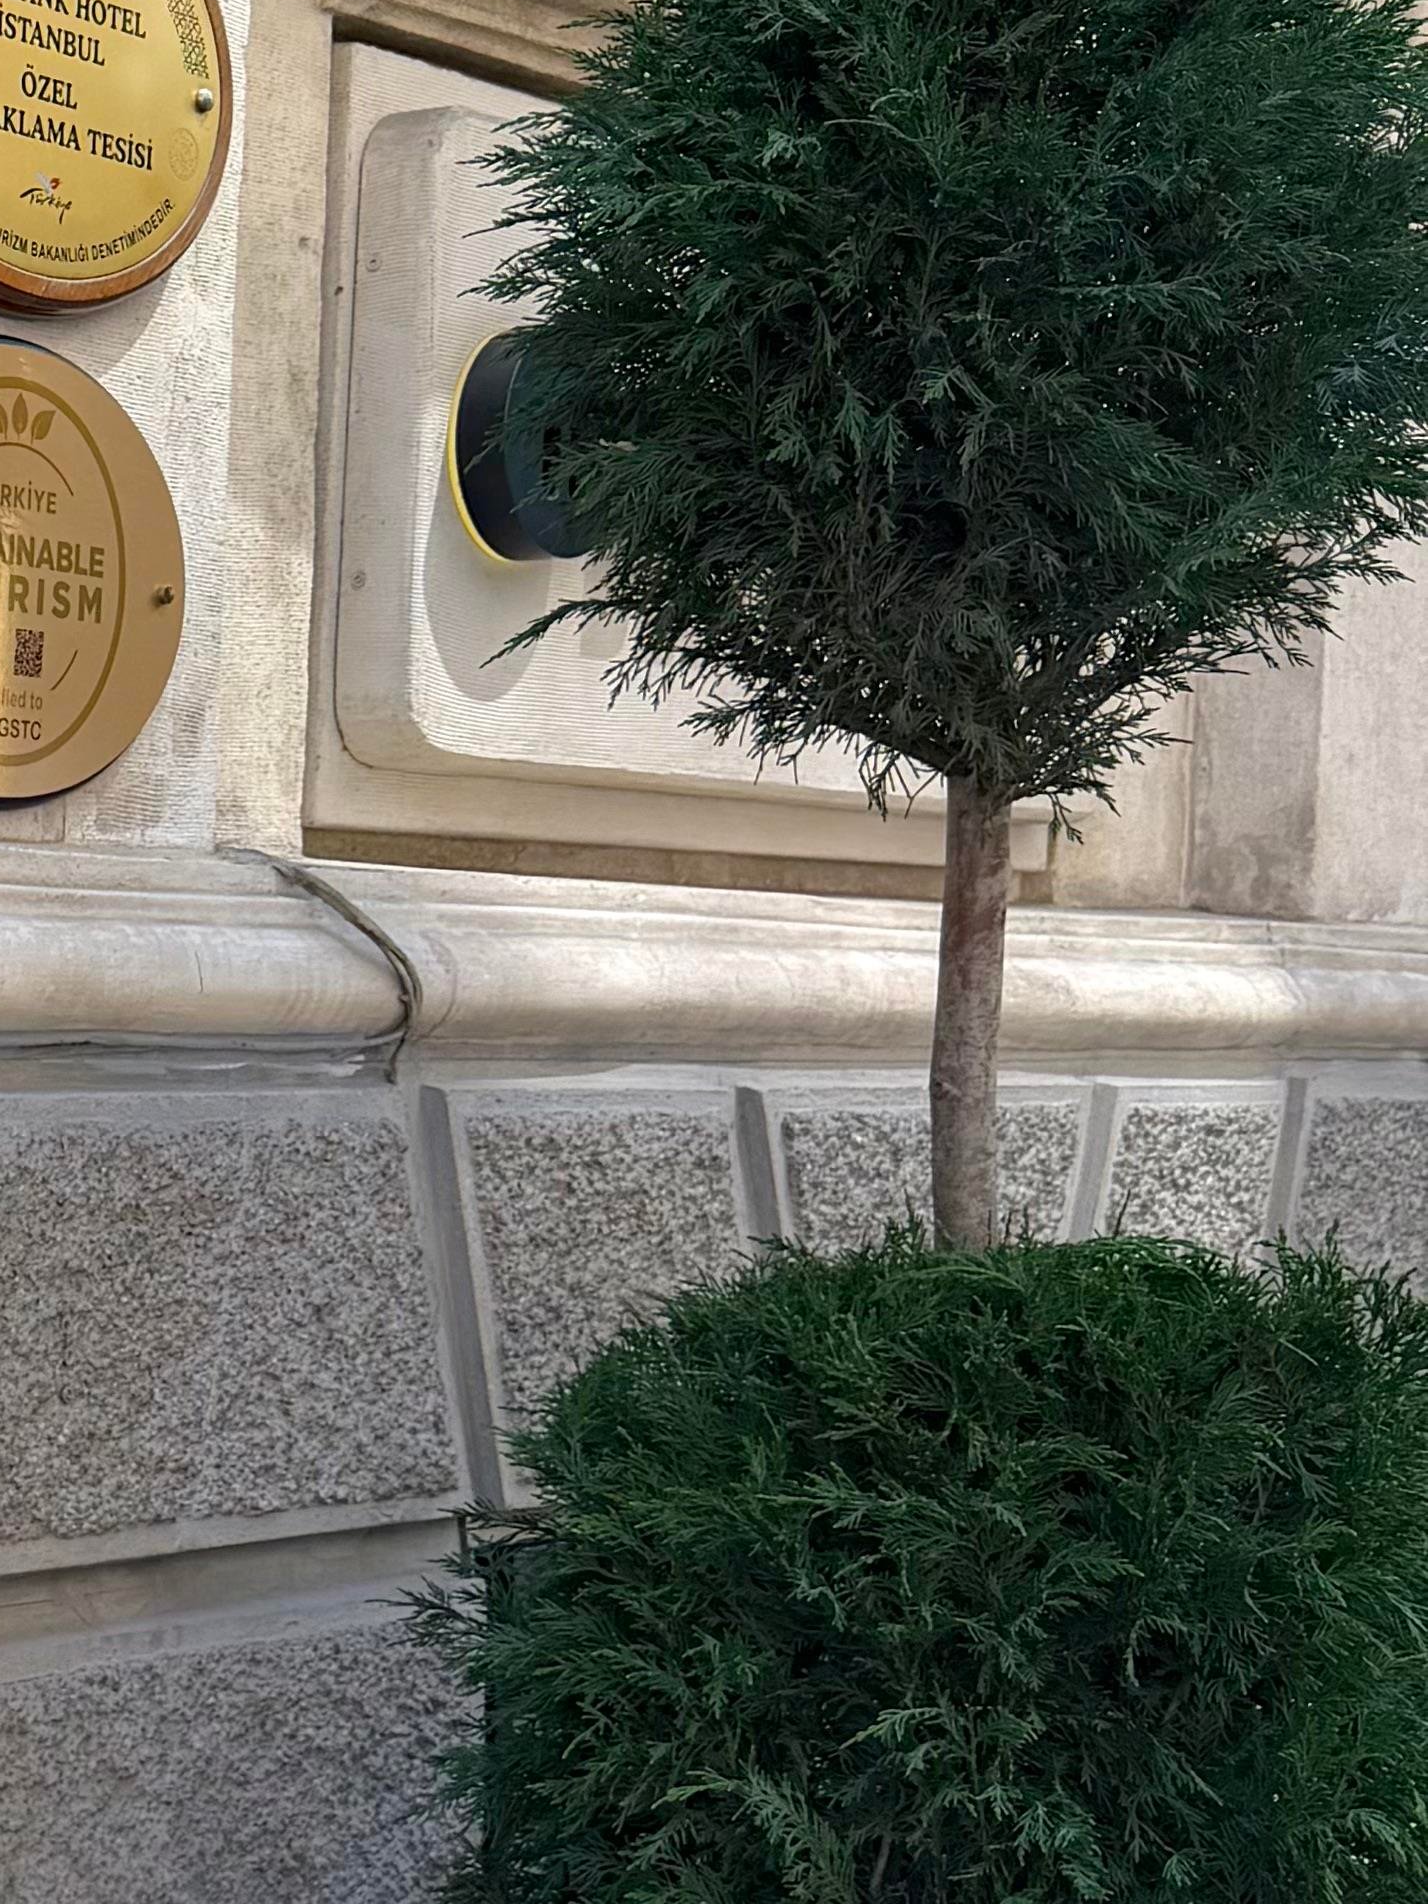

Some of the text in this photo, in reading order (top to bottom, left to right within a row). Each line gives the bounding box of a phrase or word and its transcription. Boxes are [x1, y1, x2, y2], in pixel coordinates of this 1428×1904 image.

[21, 64, 78, 110] ÖZEL
[87, 128, 153, 171] TESİSİ
[31, 241, 89, 263] BAKANLIĞI
[30, 692, 43, 710] to
